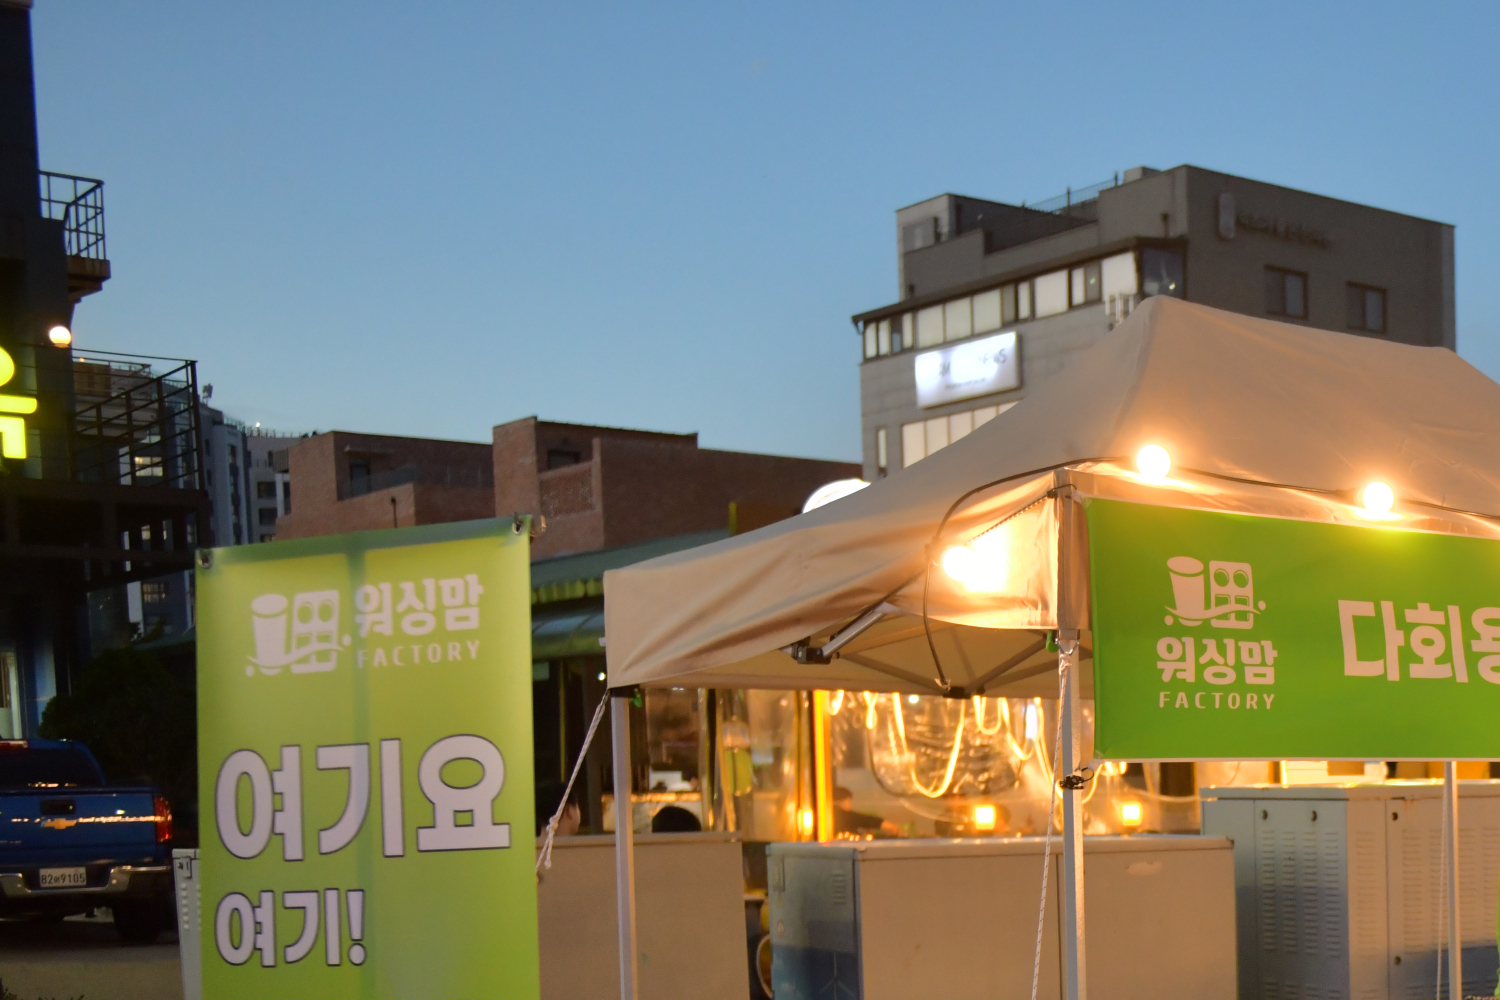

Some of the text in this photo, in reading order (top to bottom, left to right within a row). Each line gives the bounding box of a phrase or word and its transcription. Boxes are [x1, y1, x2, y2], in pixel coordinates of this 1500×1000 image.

[354, 574, 483, 636] 워싱맘
[357, 640, 480, 668] FACTORY
[1156, 637, 1278, 685] 워싱맘
[1159, 691, 1276, 711] FACTORY
[214, 733, 512, 862] 여기요
[214, 888, 367, 968] 여기!
